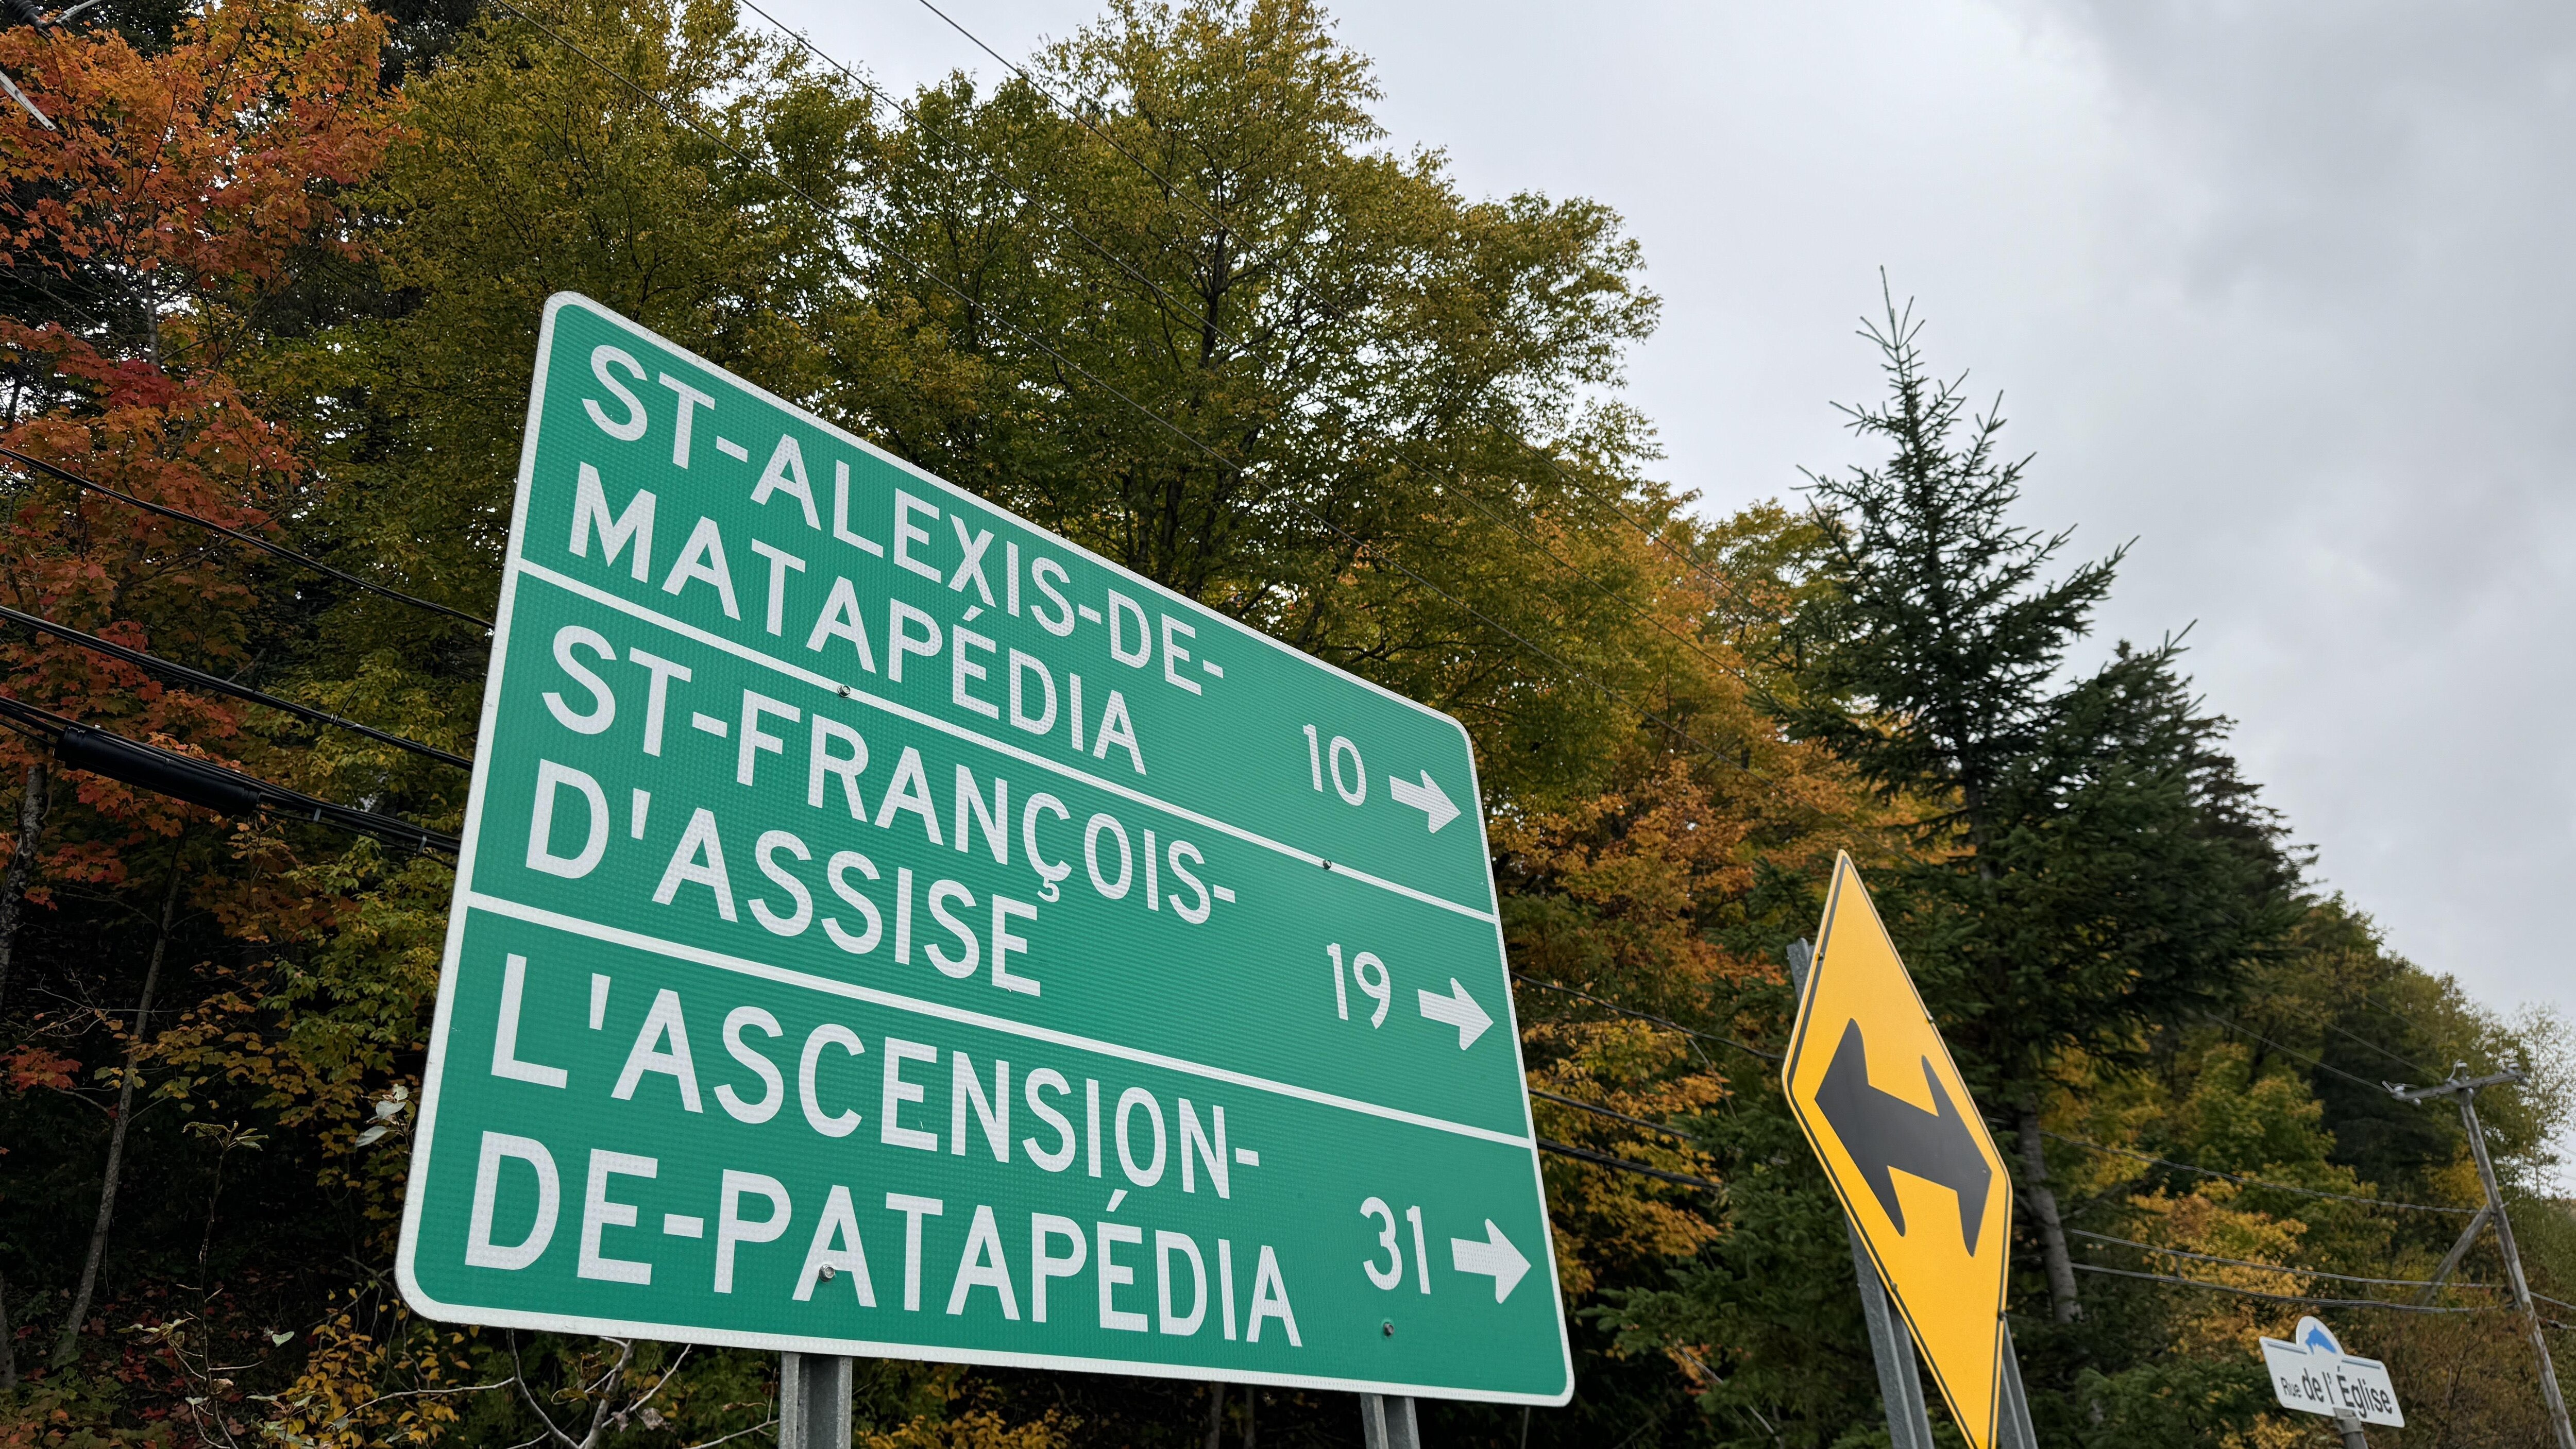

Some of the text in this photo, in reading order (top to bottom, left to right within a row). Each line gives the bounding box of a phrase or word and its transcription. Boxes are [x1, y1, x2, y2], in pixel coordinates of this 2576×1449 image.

[569, 462, 1146, 775] MATAPÉDIA
[583, 345, 1223, 695] ST-ALEXIS-DE-
[526, 759, 1040, 997] D'ASSISE
[543, 626, 1235, 924] ST-FRANÇOIS-
[1303, 724, 1366, 806] 10
[492, 953, 1259, 1199] L'ASCENSION-
[1327, 943, 1391, 1029] 19
[465, 1131, 1302, 1346] DE-PATAPÉDIA
[1360, 1197, 1430, 1294] 31
[2280, 1376, 2302, 1398] Rue
[2302, 1367, 2324, 1403] de
